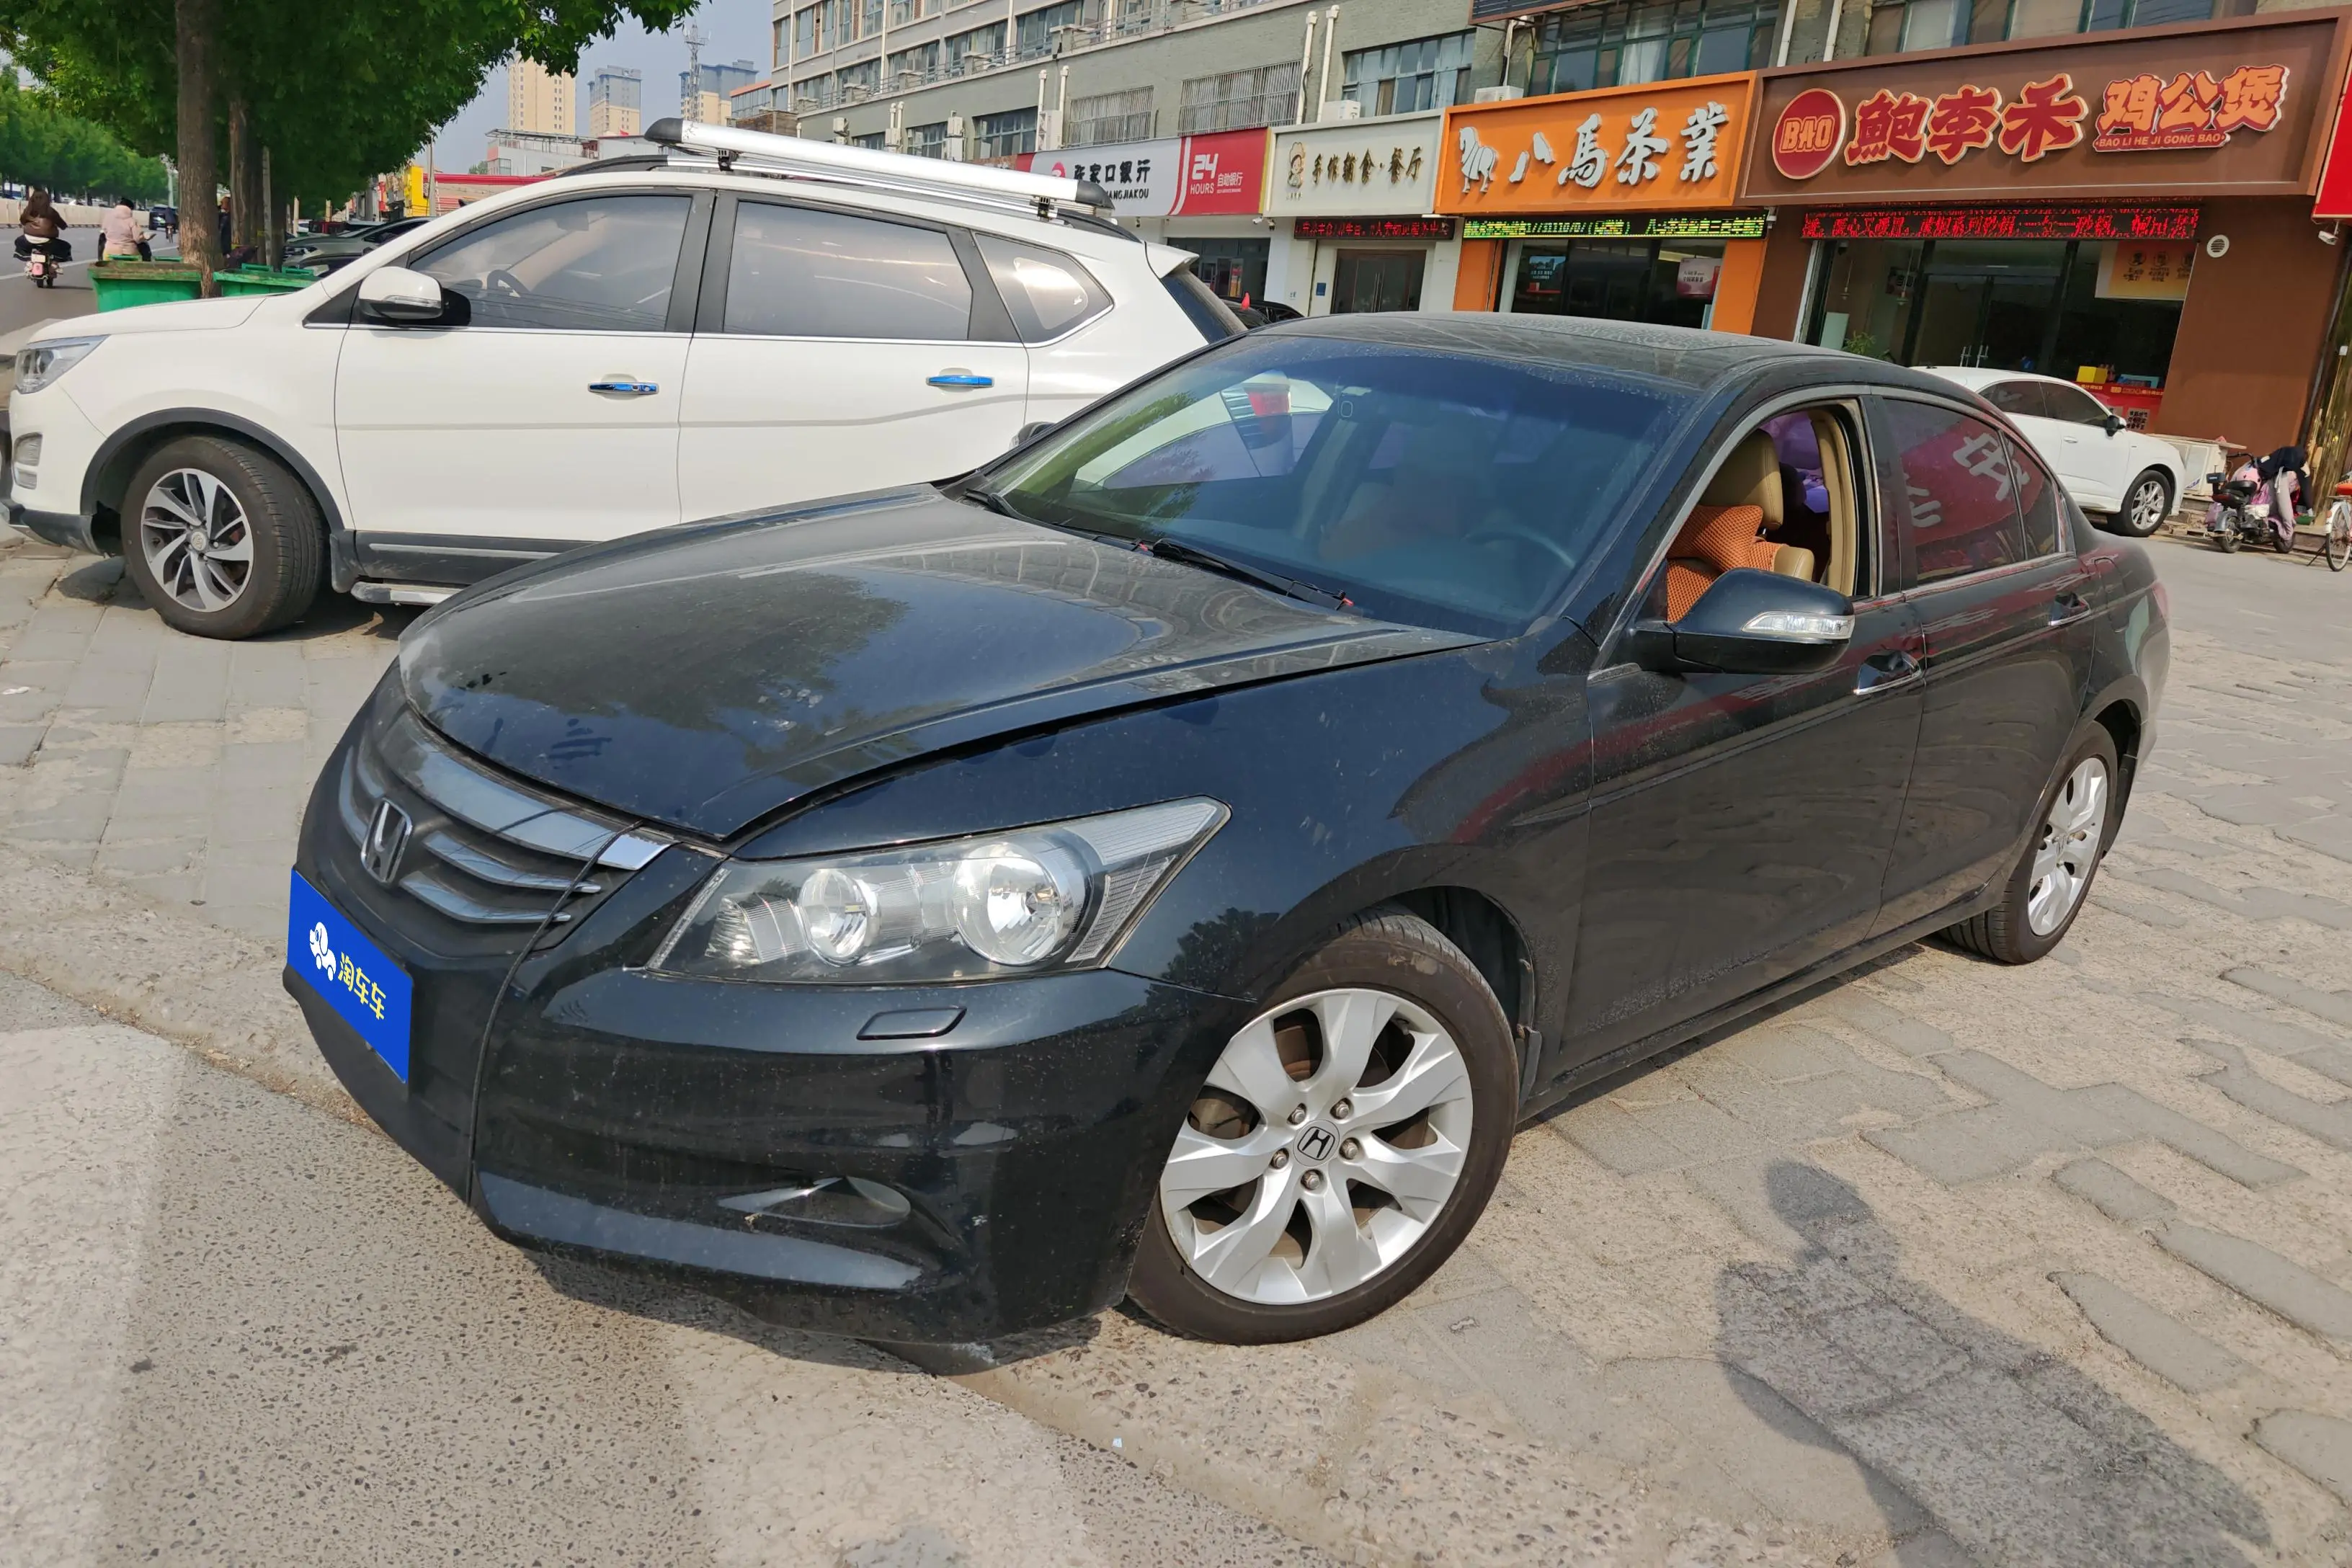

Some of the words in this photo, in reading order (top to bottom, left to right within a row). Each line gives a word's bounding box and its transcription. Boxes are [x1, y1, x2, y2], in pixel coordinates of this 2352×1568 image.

[2098, 65, 2286, 131] 鸡公煲
[1780, 115, 1836, 153] BAO
[2099, 138, 2119, 147] BAO
[2123, 137, 2132, 146] LI
[2134, 136, 2148, 145] HE
[2151, 135, 2160, 145] JI
[2164, 135, 2194, 144] GONG
[2198, 133, 2221, 143] BAO
[1193, 153, 1219, 179] 24
[1217, 172, 1243, 187] 自助银行
[1107, 188, 1149, 200] ANGJIAKOU
[1190, 182, 1215, 195] HOURS
